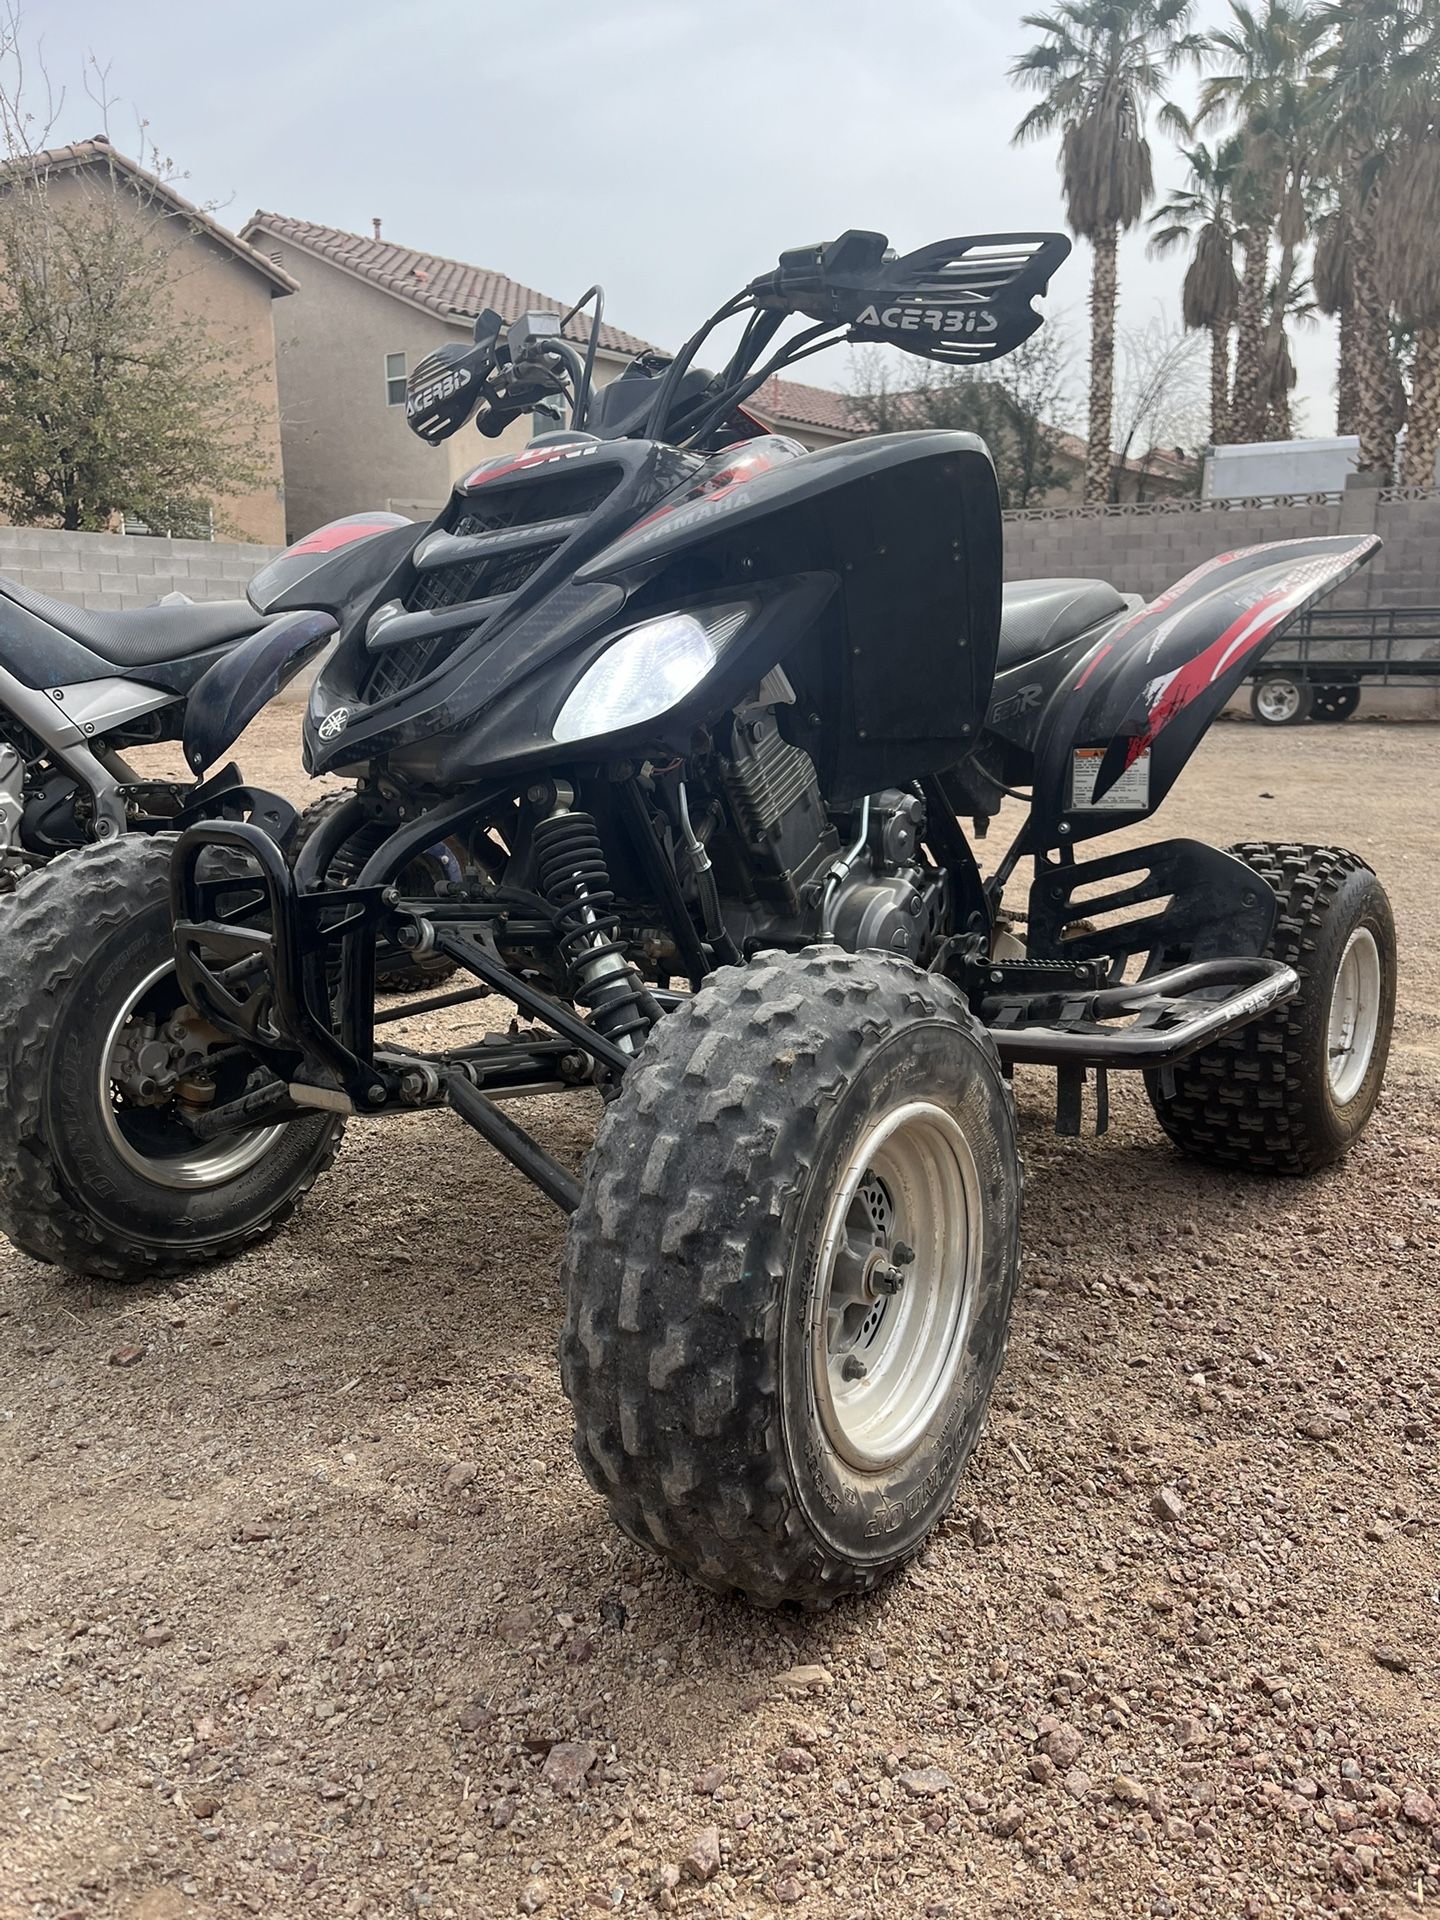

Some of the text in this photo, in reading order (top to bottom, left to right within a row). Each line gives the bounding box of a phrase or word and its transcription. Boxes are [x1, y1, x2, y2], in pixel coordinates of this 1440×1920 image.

[855, 304, 999, 333] ACERBiS
[406, 368, 472, 418] ACERBiS
[641, 492, 752, 543] YAMAHA
[61, 1032, 119, 1199] DUNLOP
[863, 1406, 969, 1539] DUNLOP
